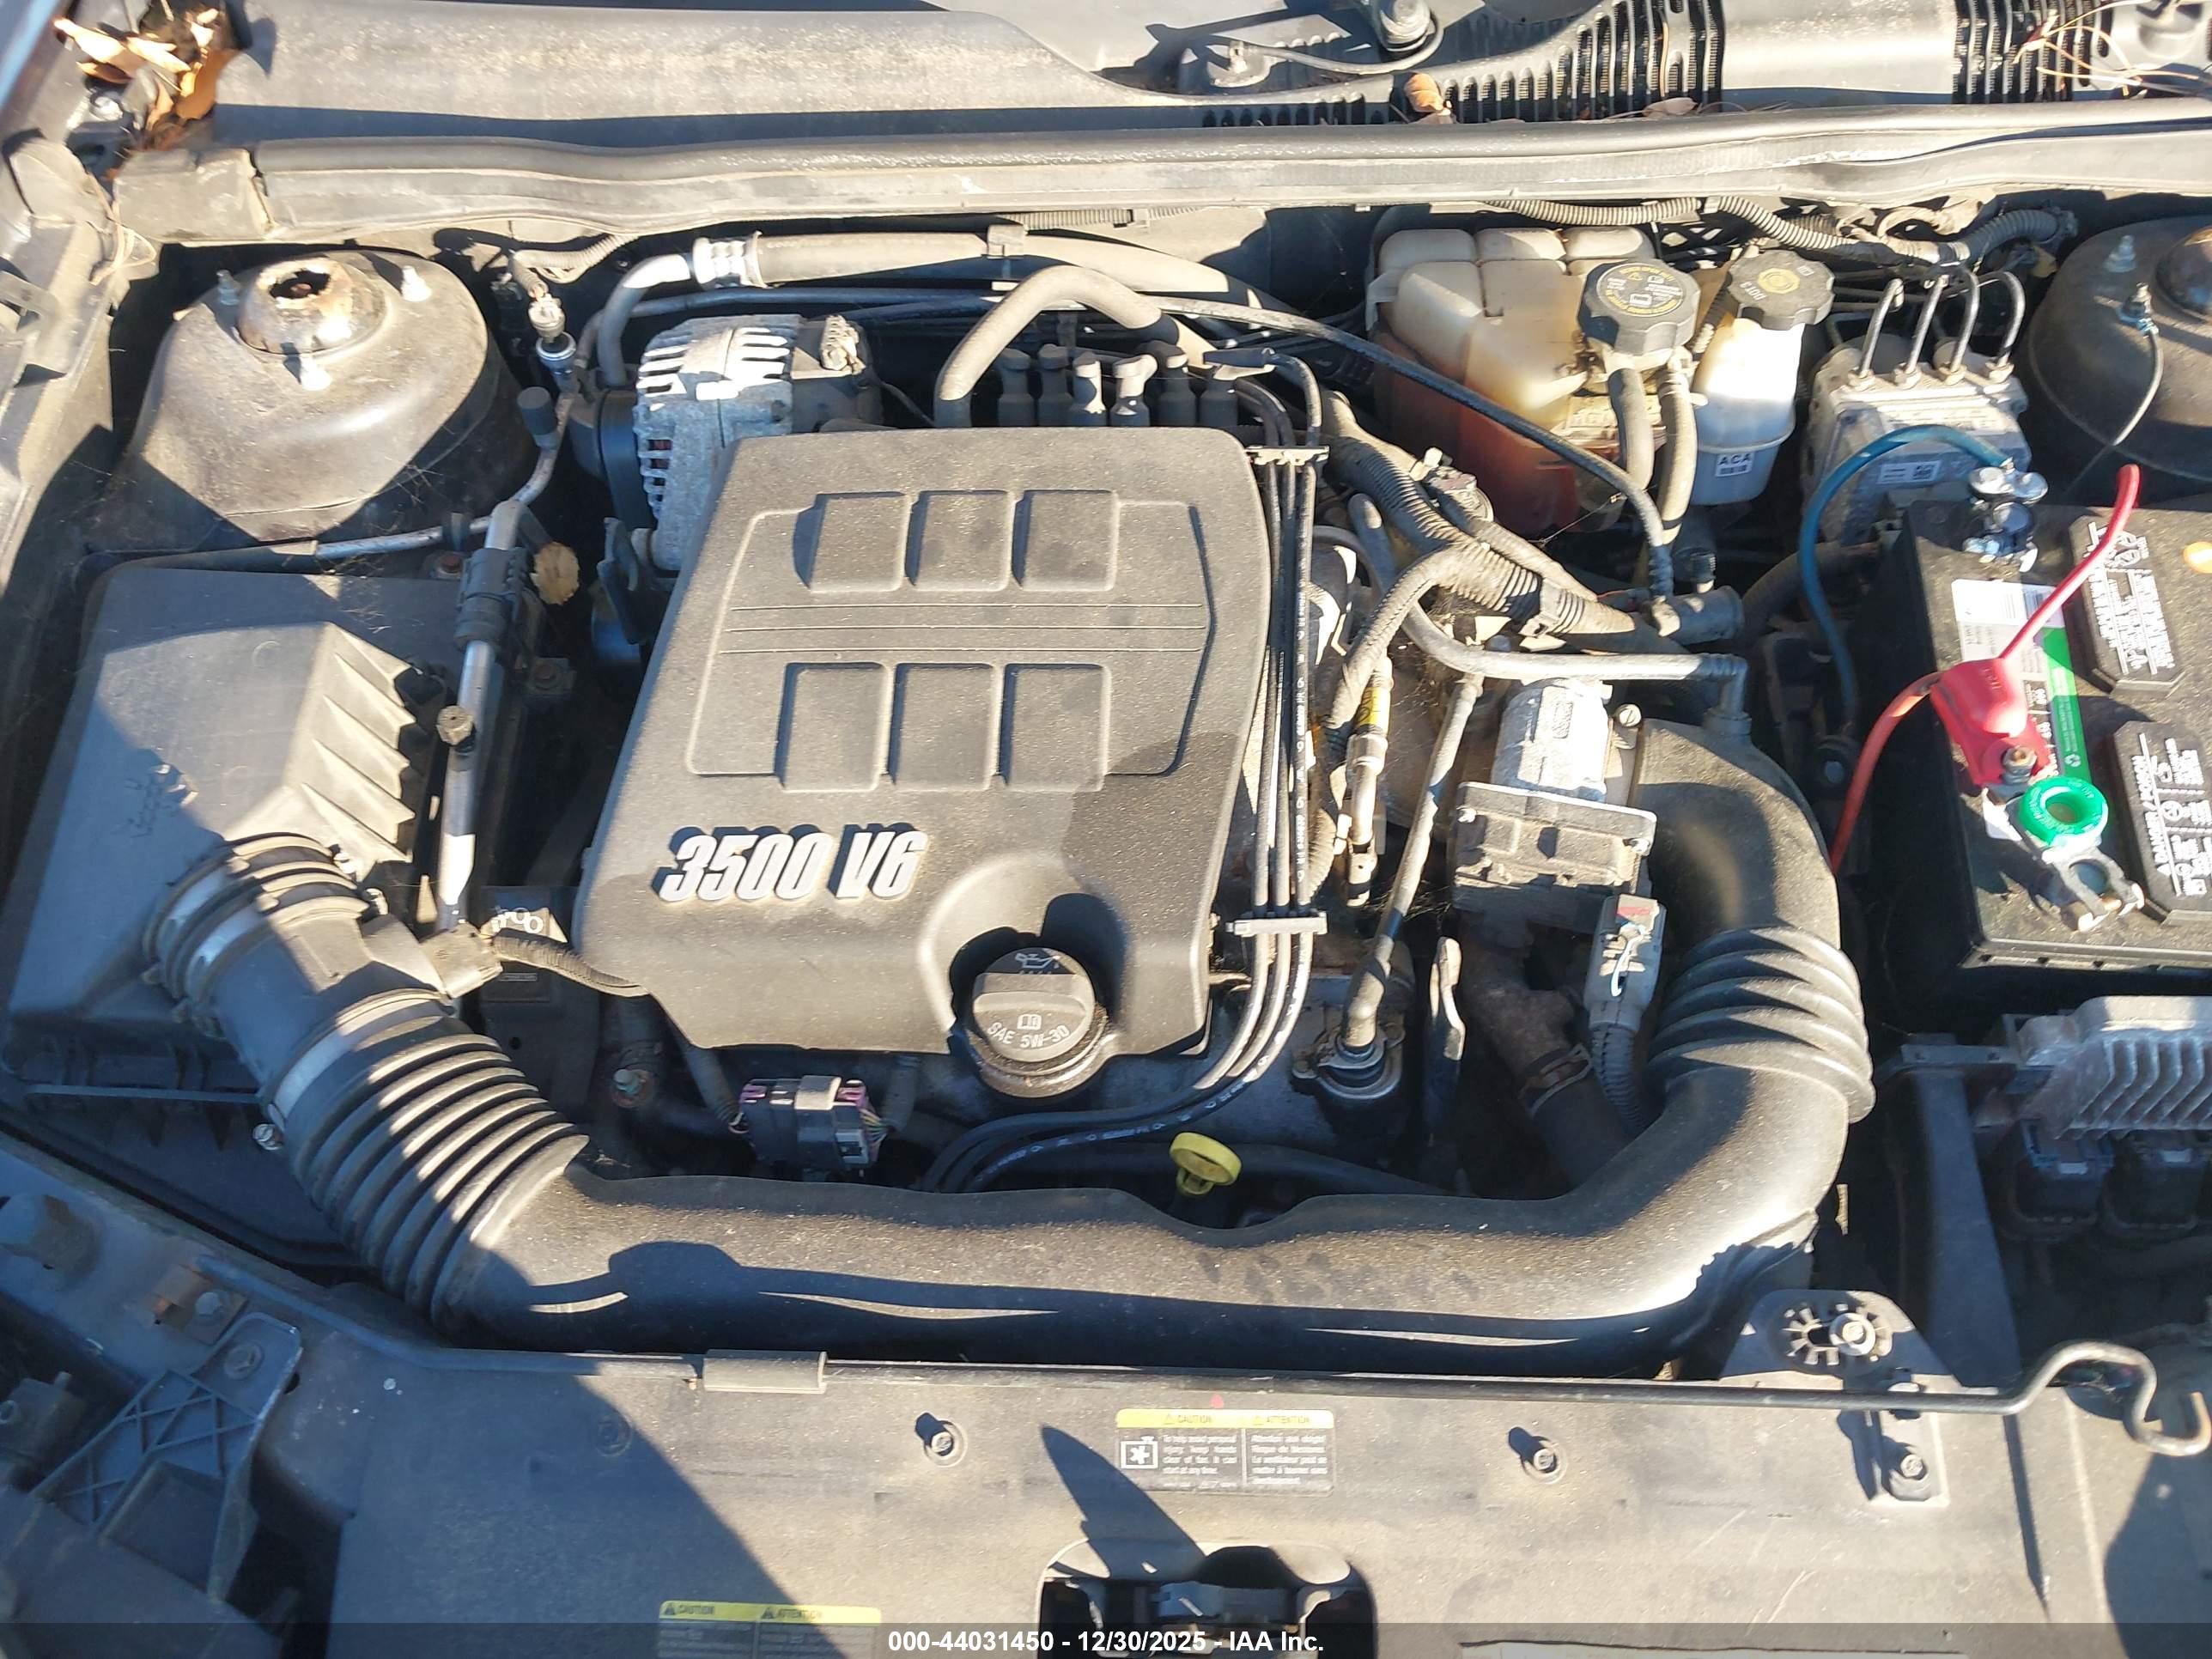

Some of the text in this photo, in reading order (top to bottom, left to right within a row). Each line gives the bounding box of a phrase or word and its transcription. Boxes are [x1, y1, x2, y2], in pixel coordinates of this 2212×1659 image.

[1717, 453, 1752, 465] ACA
[659, 830, 929, 902] 3500 V6
[988, 1021, 1071, 1048] SAE 5W-30
[1177, 1414, 1212, 1424] CAUTION
